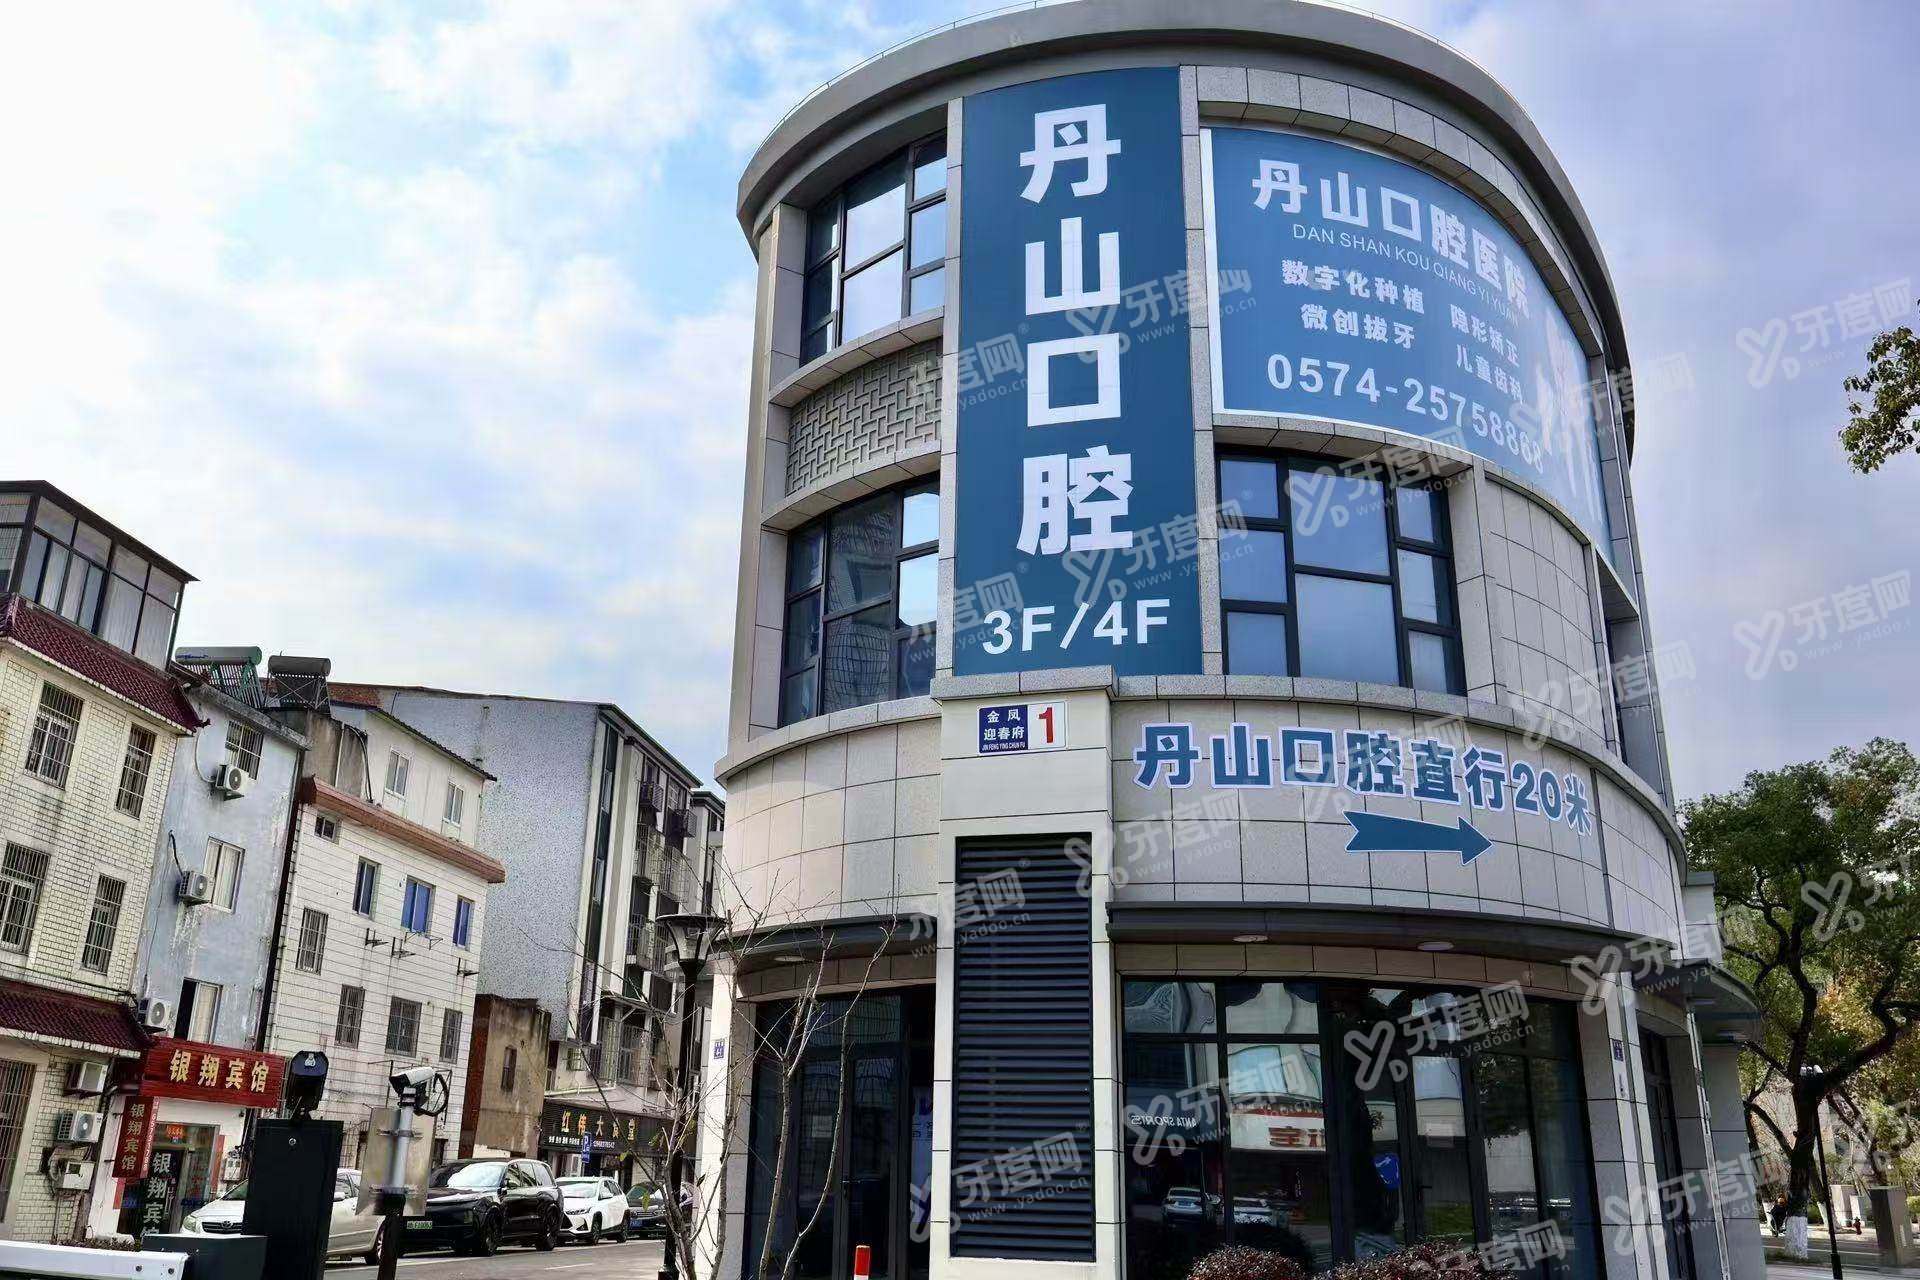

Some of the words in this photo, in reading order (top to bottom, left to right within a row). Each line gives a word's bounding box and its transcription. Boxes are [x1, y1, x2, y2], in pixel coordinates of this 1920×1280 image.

[1252, 159, 1530, 319] 丹山口腔医院
[1293, 224, 1335, 245] DAN
[1340, 234, 1391, 259] SHAN
[1395, 250, 1430, 271] KOU
[1433, 262, 1477, 296] QIANG
[1281, 259, 1425, 315] 数字化种植
[1016, 103, 1134, 555] 丹山口腔
[1300, 304, 1416, 350] 微创拔牙
[982, 598, 1170, 655] 3F/4F
[983, 725, 1025, 741] 迎春府
[986, 708, 1021, 723] 金凤
[1038, 707, 1054, 744] 1
[1132, 721, 1593, 840] 丹山口腔直行20米
[170, 1049, 271, 1093] 银翔宾馆
[121, 1103, 146, 1171] 银翔宾馆
